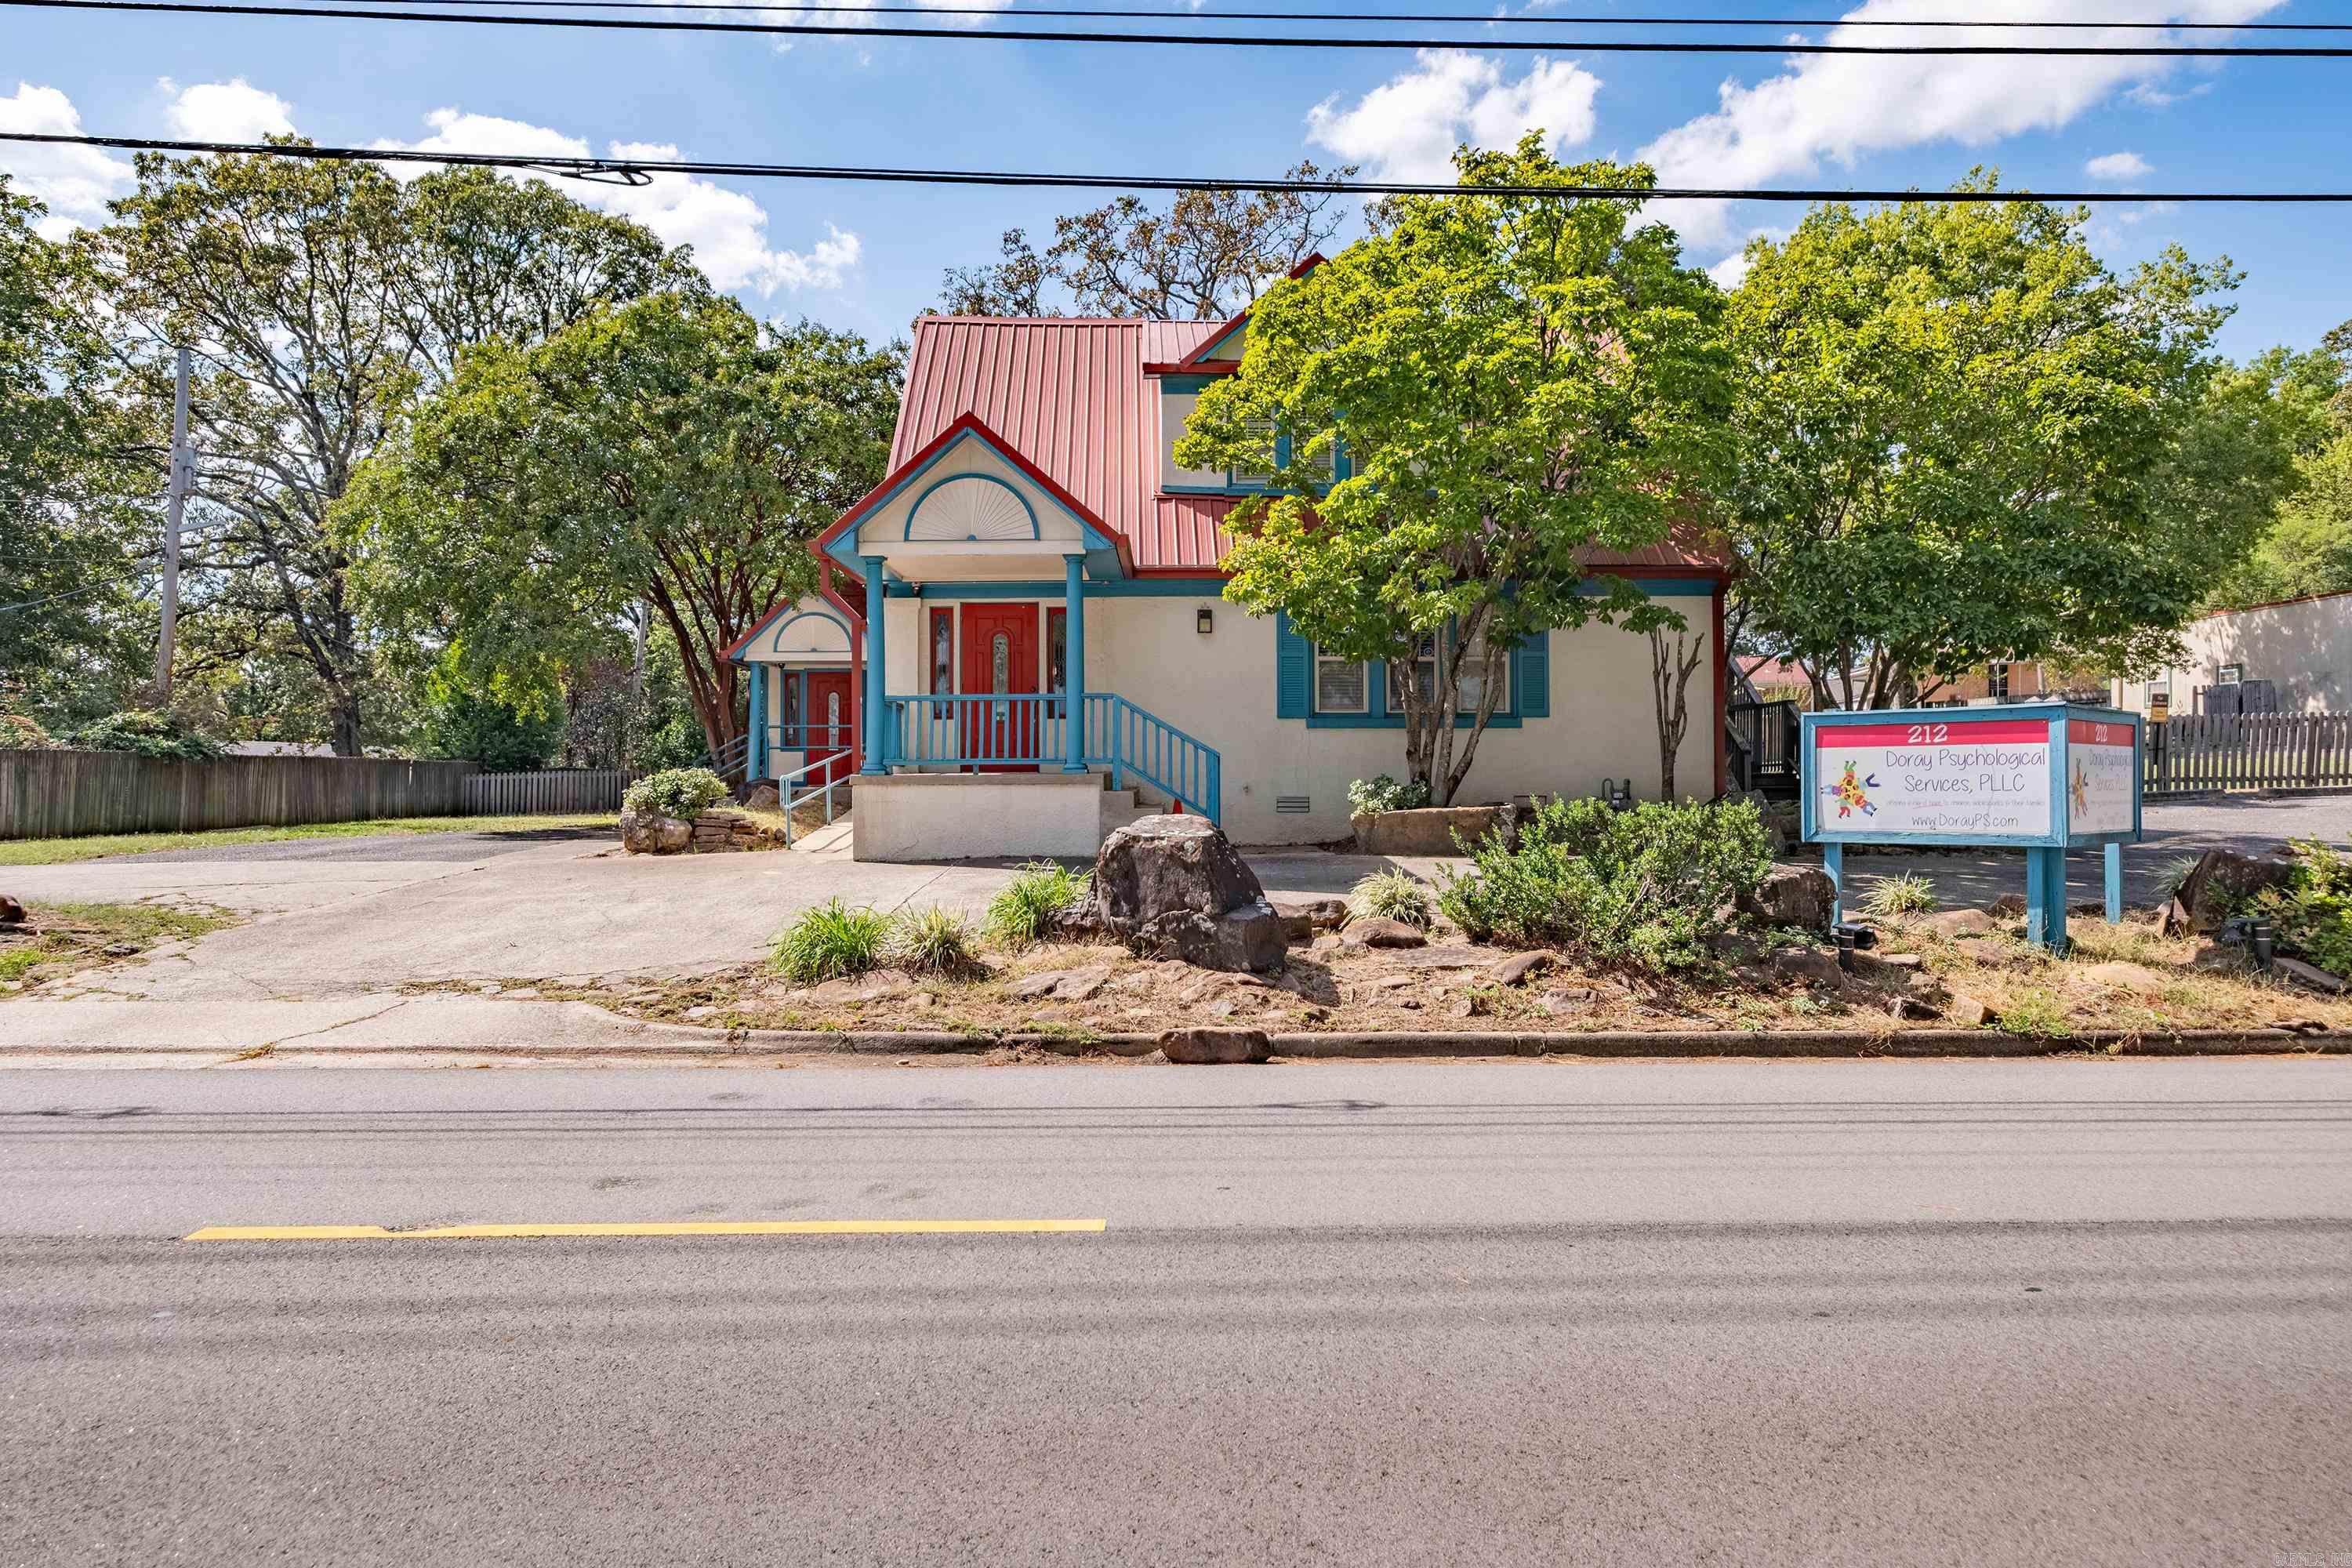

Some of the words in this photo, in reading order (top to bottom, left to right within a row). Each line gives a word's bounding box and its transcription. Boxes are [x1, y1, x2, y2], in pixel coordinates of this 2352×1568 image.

[1907, 724, 1948, 743] 212
[2096, 724, 2107, 742] 212
[1886, 750, 1933, 771] Doray
[1939, 746, 2045, 771] Psychological
[1905, 775, 1973, 793] Services,
[1980, 773, 2026, 792] PLLC
[1911, 812, 2019, 830] www.DorayPS.com
